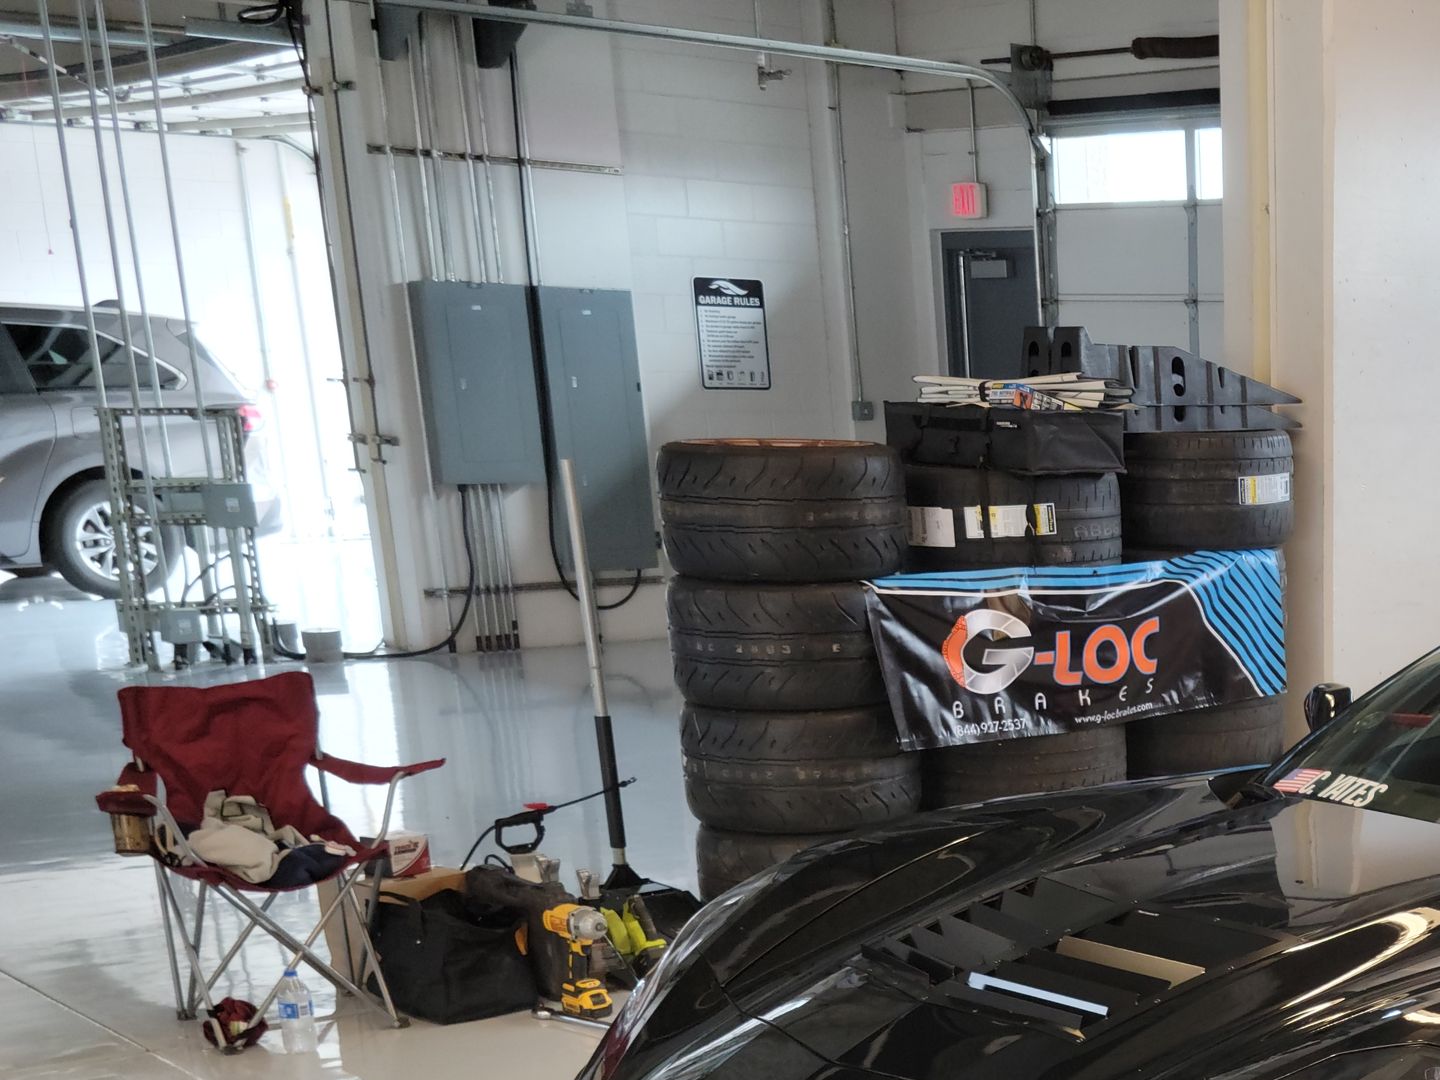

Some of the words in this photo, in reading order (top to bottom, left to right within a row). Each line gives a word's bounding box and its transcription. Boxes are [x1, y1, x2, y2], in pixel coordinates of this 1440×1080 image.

[953, 184, 977, 216] EXIT
[698, 295, 732, 306] GARAGE
[734, 297, 761, 306] RULES
[943, 608, 1160, 695] G-LOC
[952, 677, 1155, 719] BRAKES
[1298, 770, 1332, 795] C.
[1317, 773, 1389, 808] YATES
